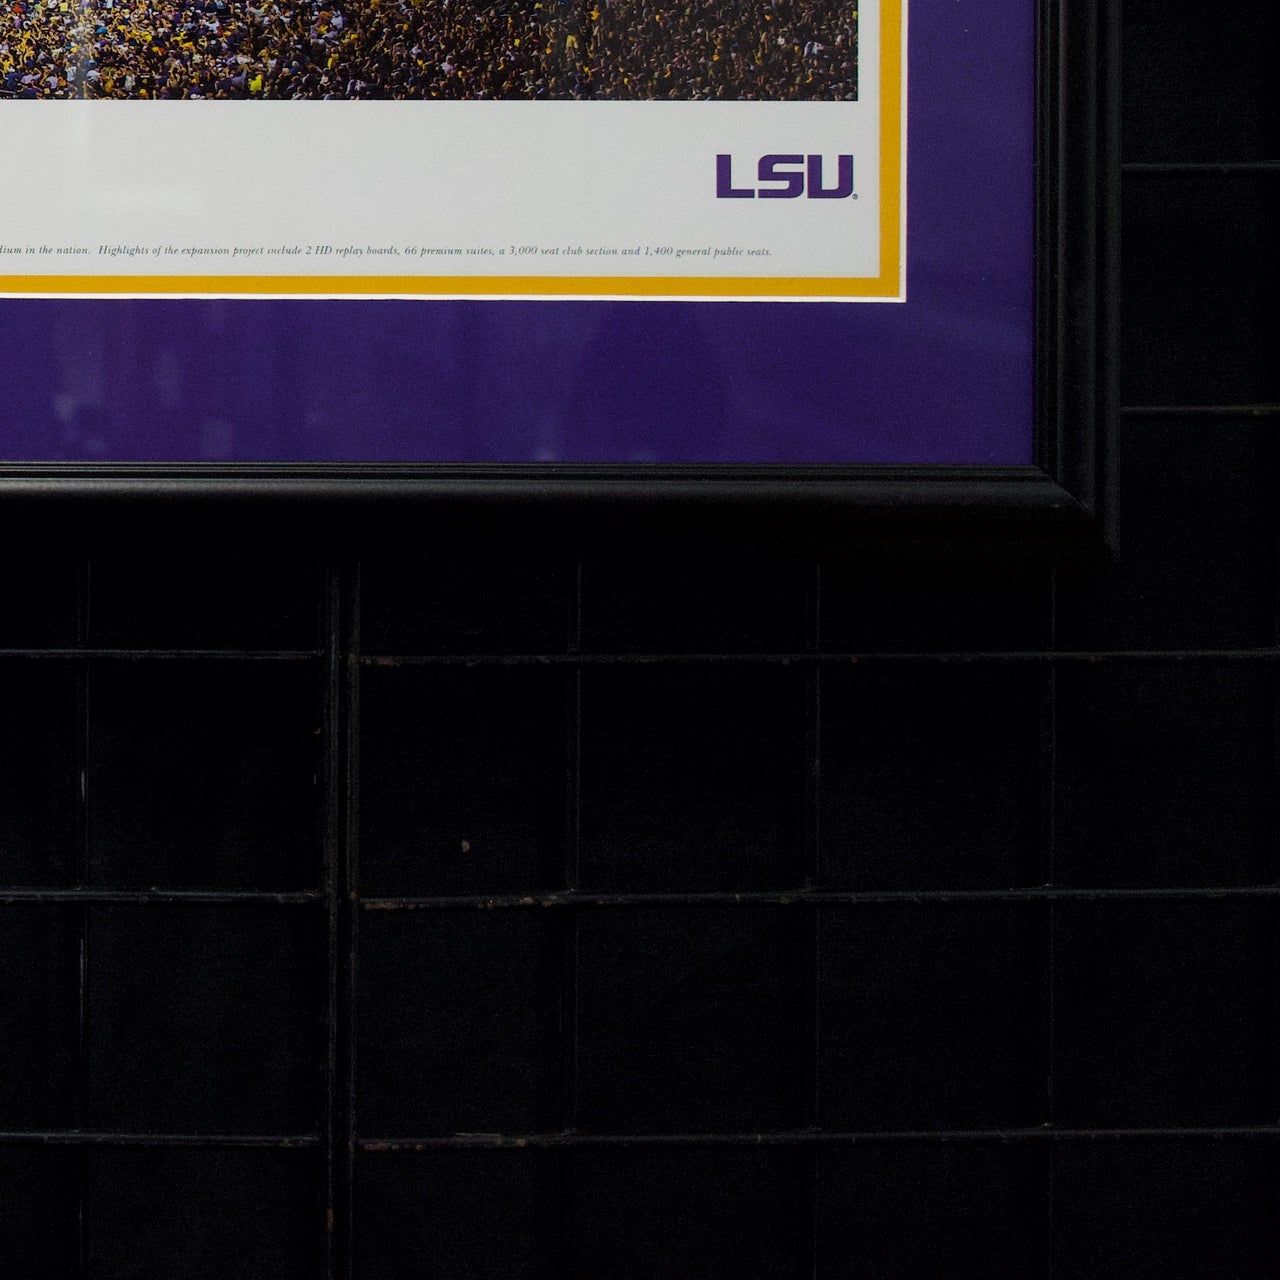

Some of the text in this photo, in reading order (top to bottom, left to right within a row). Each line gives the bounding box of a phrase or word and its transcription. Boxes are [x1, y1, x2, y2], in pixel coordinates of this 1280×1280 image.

[25, 246, 35, 254] in
[39, 245, 53, 254] the
[98, 245, 149, 257] Highlights
[151, 245, 162, 257] of
[164, 245, 178, 255] the
[181, 246, 230, 257] expansion
[232, 246, 265, 257] project
[267, 245, 303, 255] include
[305, 245, 313, 255] 2
[315, 245, 333, 255] HD
[335, 246, 364, 257] replay
[404, 246, 418, 255] 66
[419, 247, 463, 258] premium
[498, 248, 505, 256] a
[540, 247, 560, 256] seat
[562, 246, 582, 256] club
[585, 247, 618, 256] section
[621, 246, 641, 256] and
[674, 246, 712, 258] general
[713, 246, 743, 258] public
